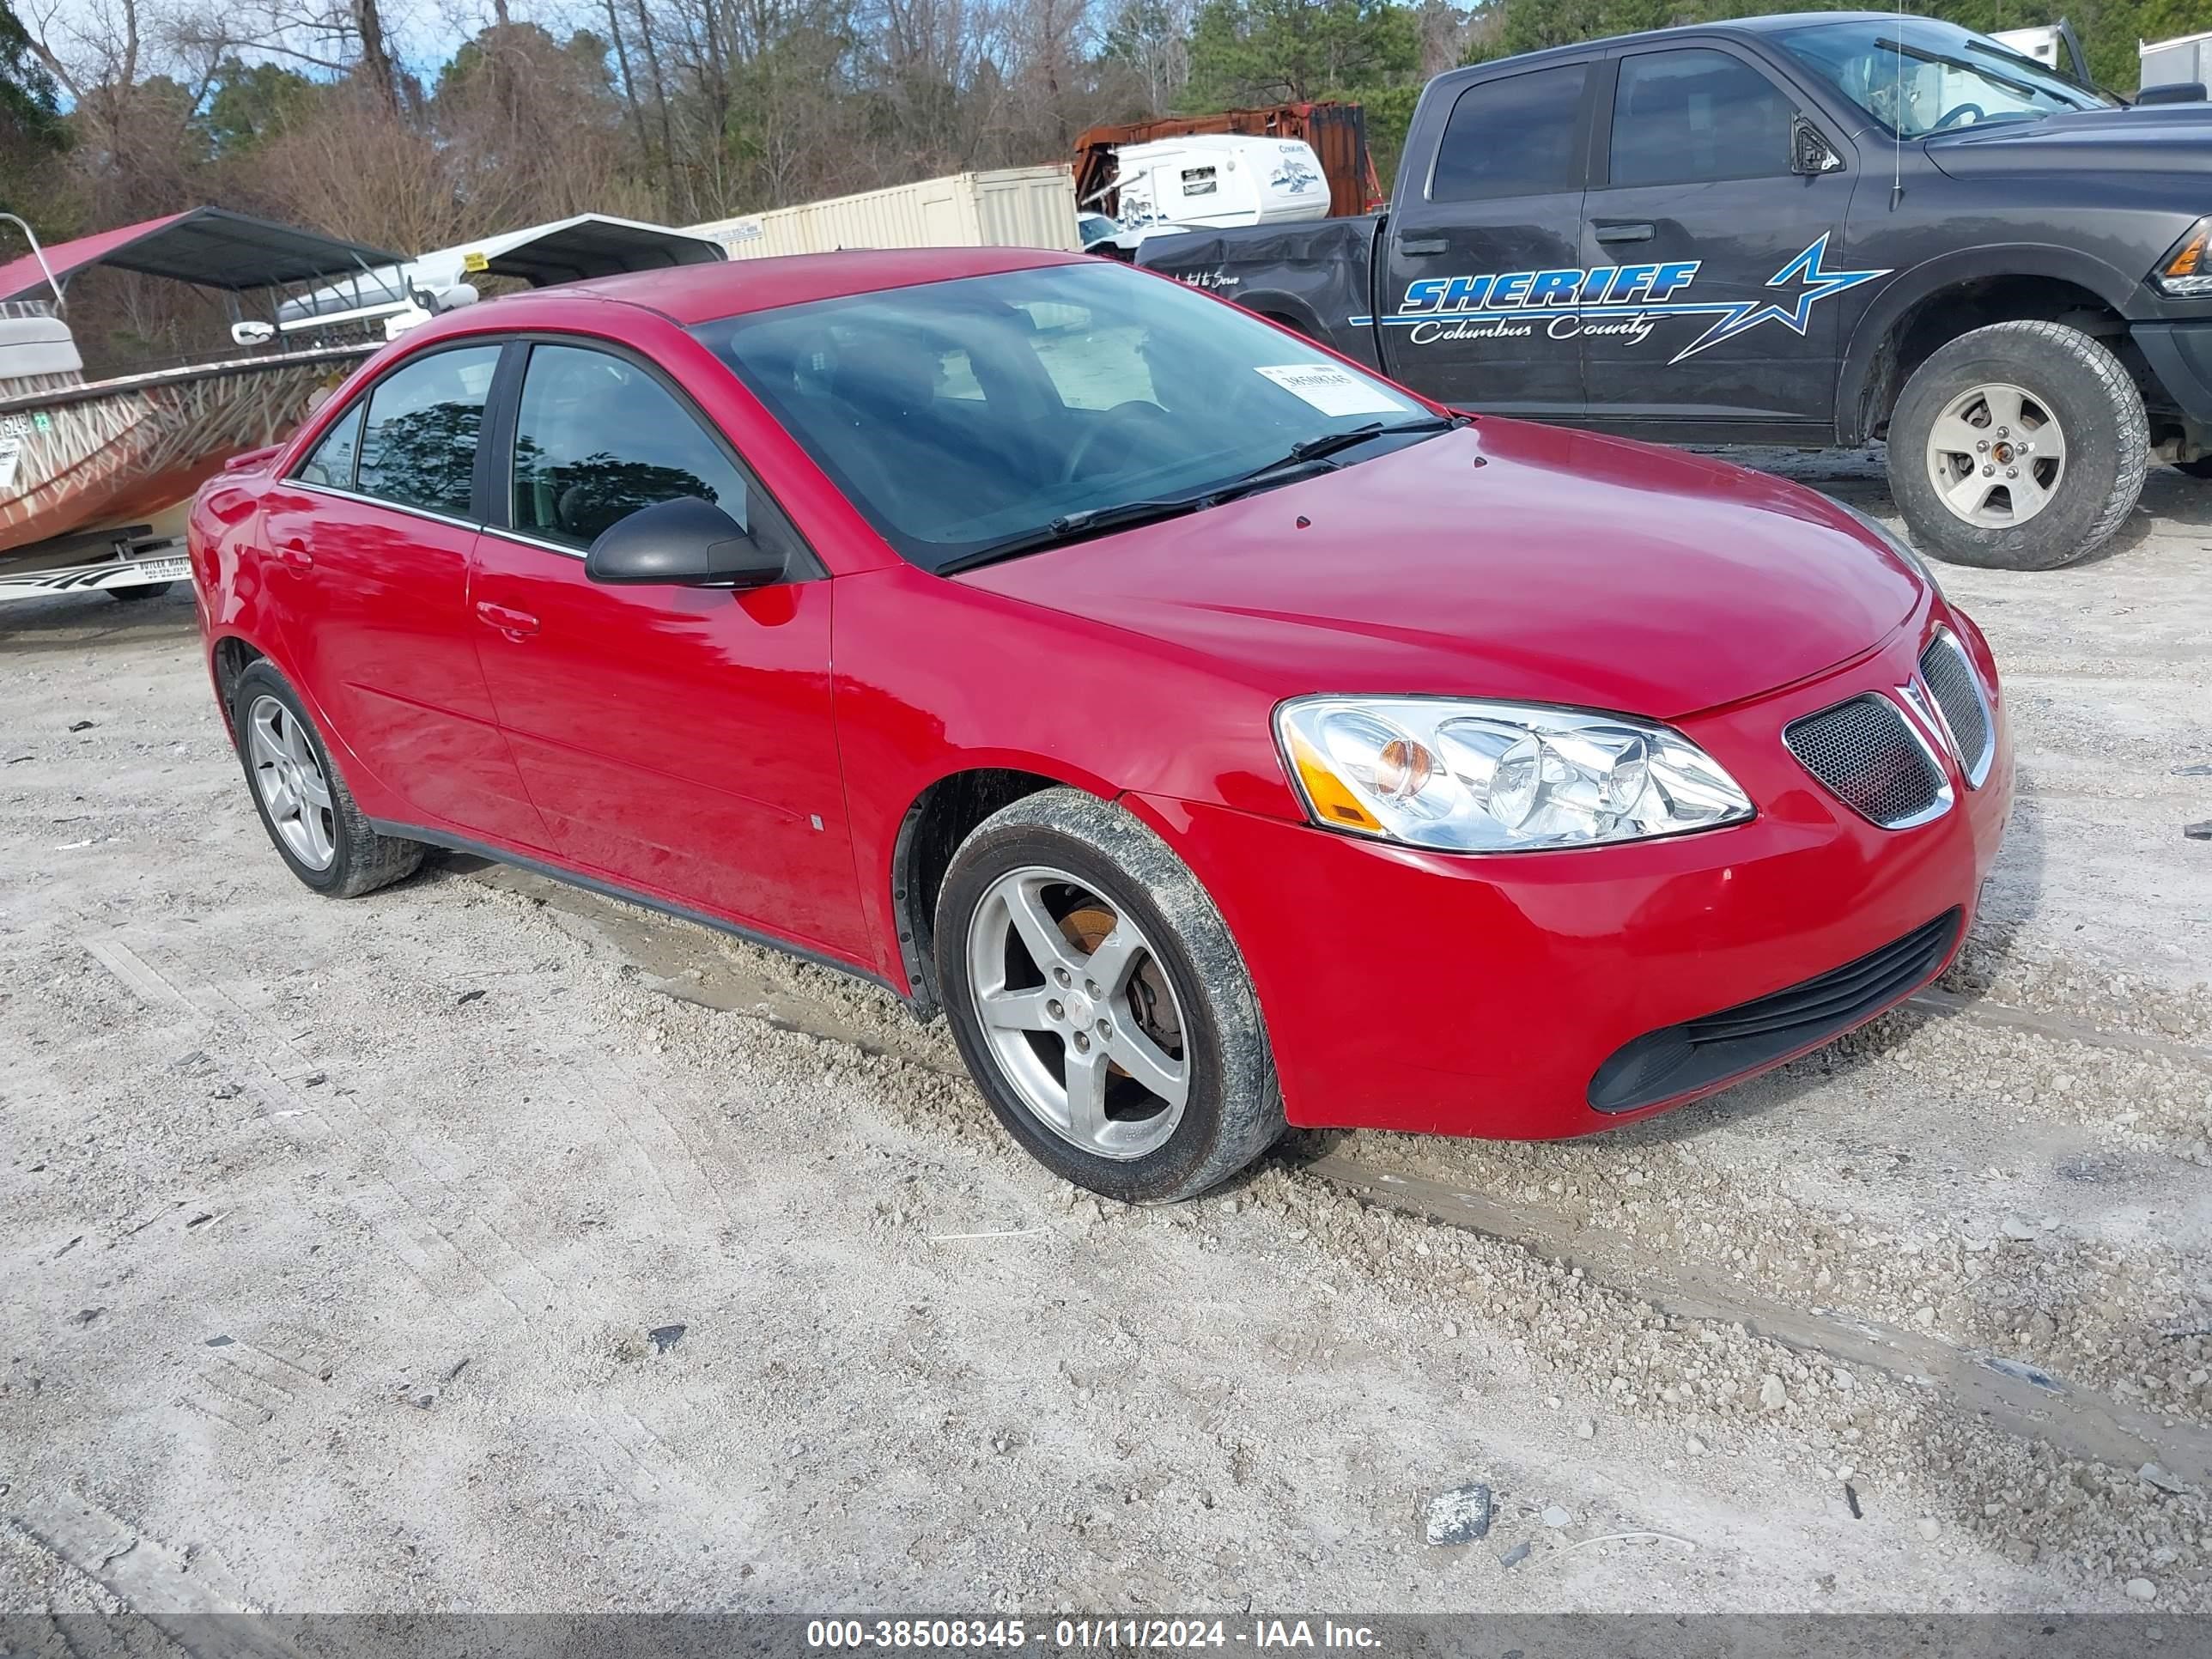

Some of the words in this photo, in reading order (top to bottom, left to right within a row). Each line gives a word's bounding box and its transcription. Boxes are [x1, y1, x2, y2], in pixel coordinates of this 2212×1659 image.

[1398, 260, 1702, 314] SHERIFF
[1410, 318, 1532, 344] Columbus
[1547, 312, 1672, 346] County
[1281, 374, 1353, 387] 38508345
